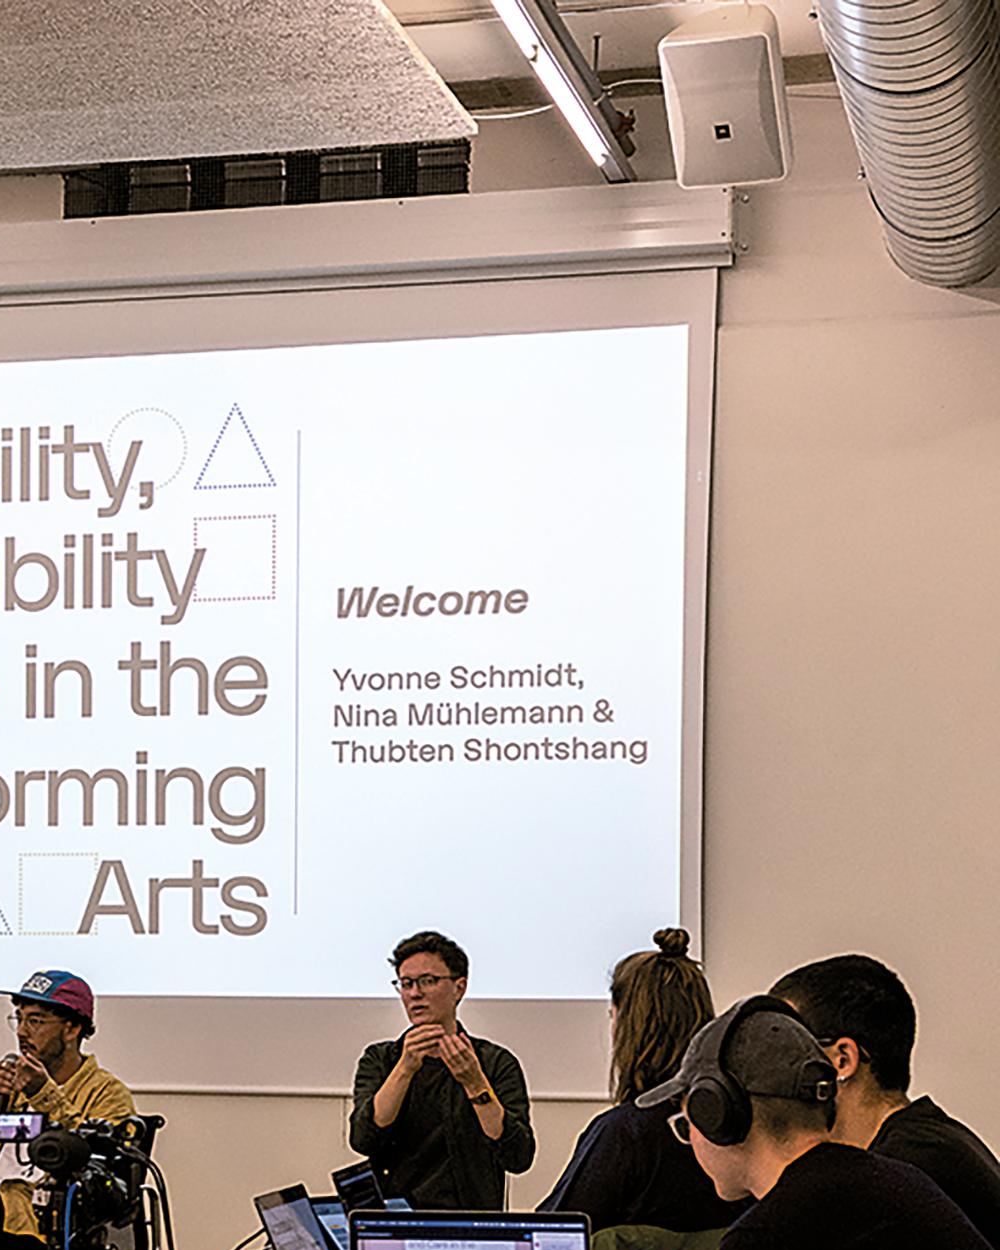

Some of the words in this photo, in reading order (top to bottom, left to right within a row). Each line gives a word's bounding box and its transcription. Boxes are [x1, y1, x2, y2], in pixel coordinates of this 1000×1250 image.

[337, 585, 528, 619] Welcome
[25, 644, 92, 719] in
[118, 640, 268, 716] the
[333, 668, 440, 691] Yvonne
[450, 663, 584, 690] Schmidt,
[334, 704, 397, 727] Nina
[408, 702, 583, 726] Mühlemann
[593, 699, 614, 723] &
[331, 739, 454, 763] Thubten
[464, 737, 647, 764] Shontshang
[77, 859, 268, 936] Arts
